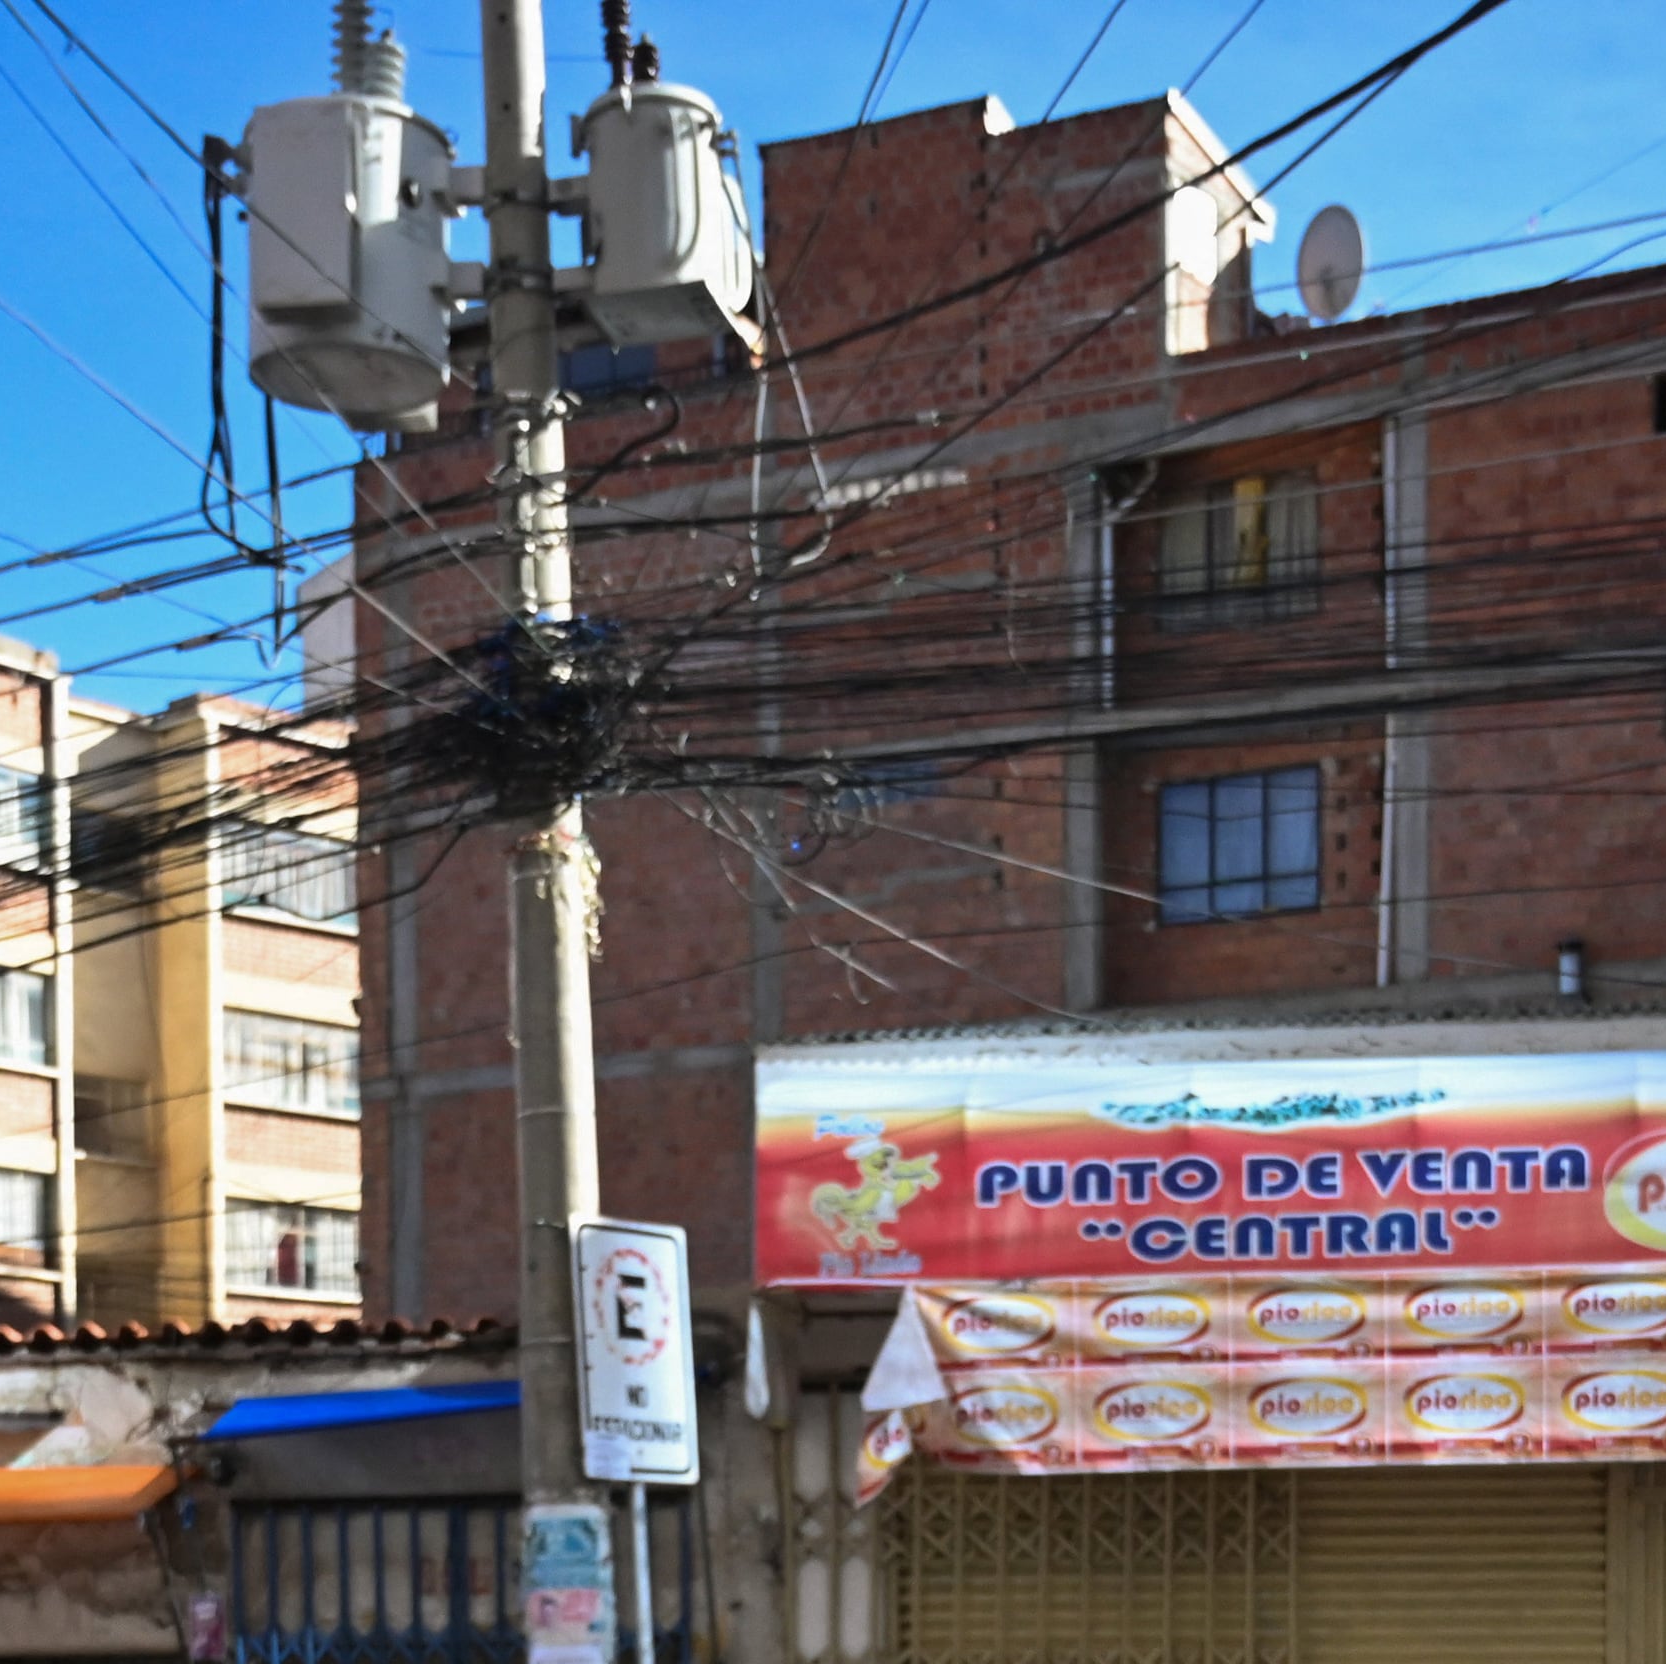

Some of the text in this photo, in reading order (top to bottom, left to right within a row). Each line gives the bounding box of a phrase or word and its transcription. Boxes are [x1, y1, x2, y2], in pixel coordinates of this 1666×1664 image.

[977, 1146, 1590, 1207] PUNTO DE VENTA
